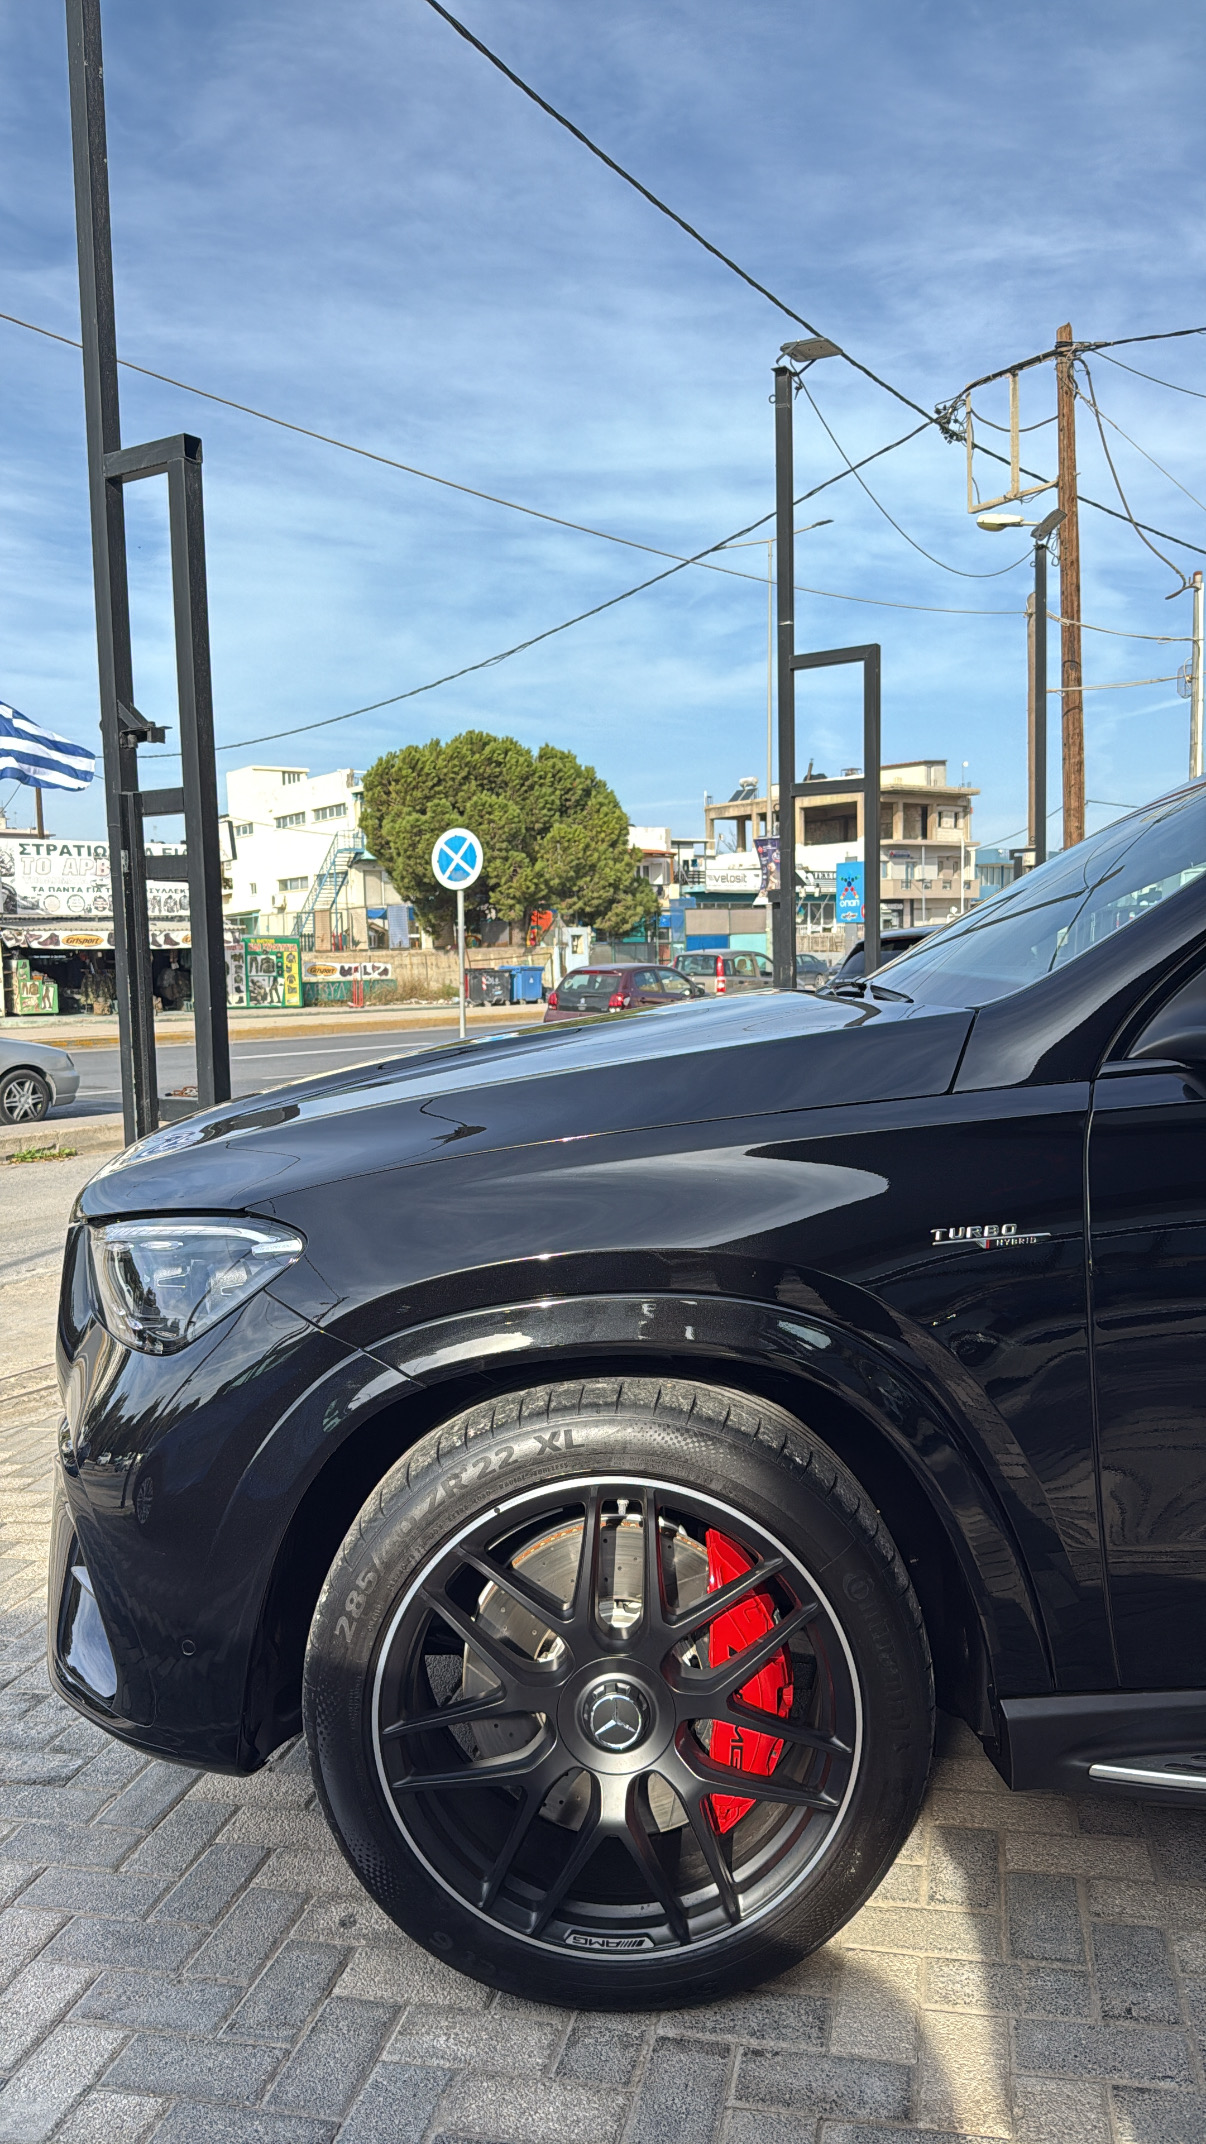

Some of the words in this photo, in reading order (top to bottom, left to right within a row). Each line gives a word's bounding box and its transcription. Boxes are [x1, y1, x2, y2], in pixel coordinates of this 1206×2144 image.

[930, 1223, 1017, 1241] TURBO
[996, 1237, 1037, 1247] HYBRID
[533, 1428, 586, 1456] XL
